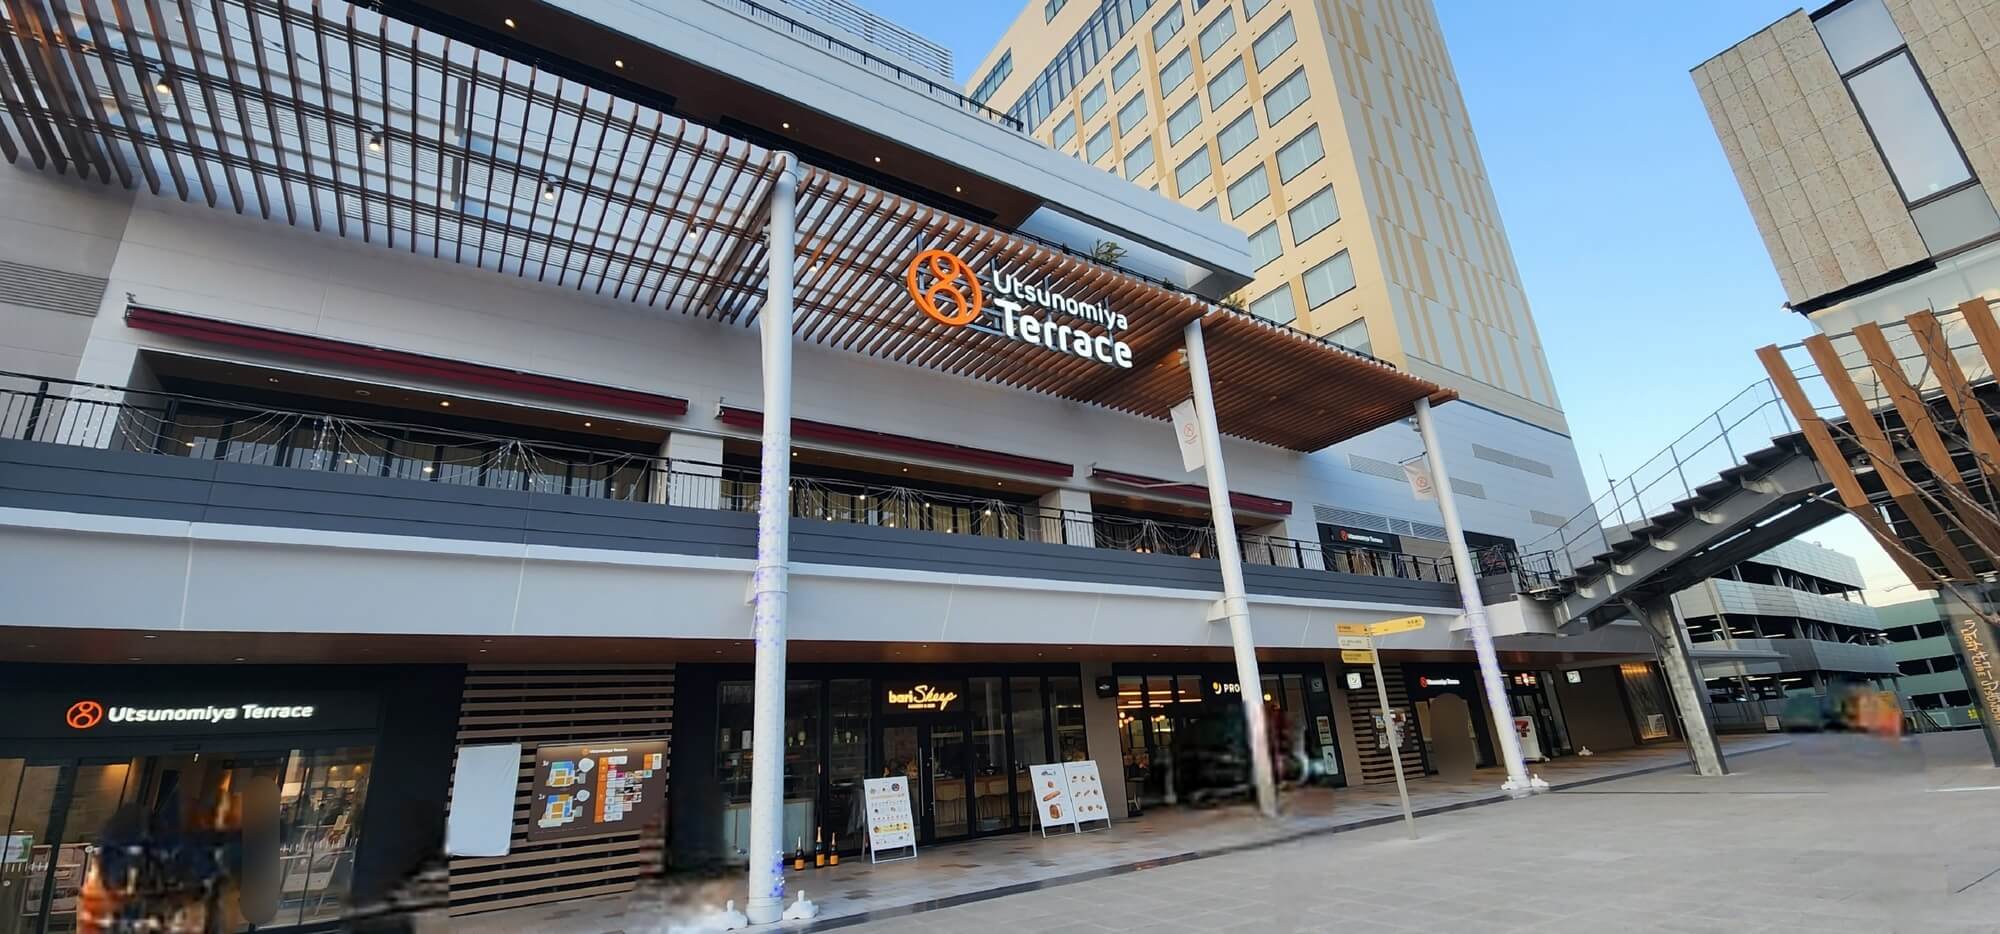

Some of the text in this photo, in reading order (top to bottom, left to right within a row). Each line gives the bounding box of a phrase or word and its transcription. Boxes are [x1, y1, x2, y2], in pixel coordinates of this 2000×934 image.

[993, 270, 1128, 330] Utsunomiya
[993, 298, 1133, 369] Terrace
[1223, 683, 1241, 693] PRO
[108, 703, 314, 723] Utsunomiya Terrace
